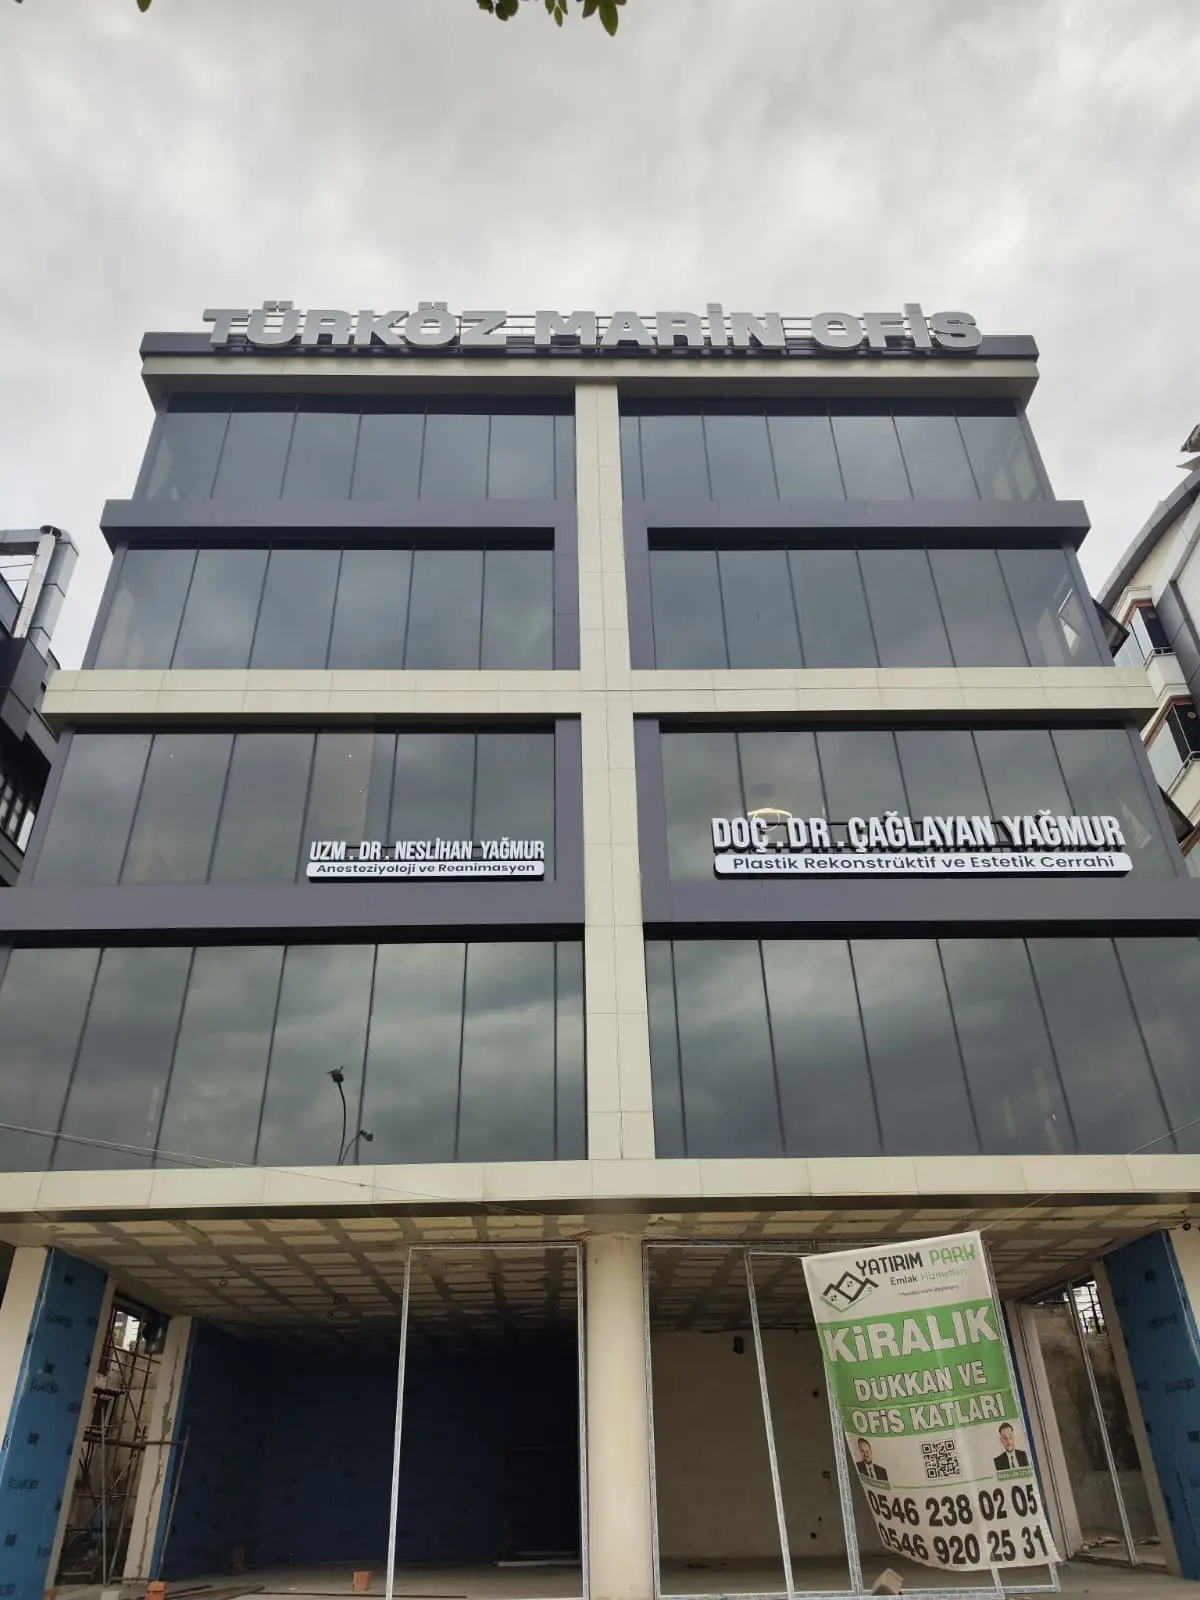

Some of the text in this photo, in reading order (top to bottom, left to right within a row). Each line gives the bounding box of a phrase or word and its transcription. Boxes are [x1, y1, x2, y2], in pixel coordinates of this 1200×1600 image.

[202, 301, 983, 351] TÜRKÖZ MARİN OFİS
[394, 837, 473, 860] NESLİHAN
[480, 836, 545, 860] YAĞMUR
[848, 810, 996, 853] ÇAĞLAYAN
[1001, 809, 1126, 847] YAĞMUR
[316, 863, 416, 875] Anesteziyoloji
[438, 863, 535, 874] Reanimasyon
[732, 855, 1116, 870] Plastik Rekonstrüktif ve Estetik Cerrahi
[856, 1243, 976, 1276] YATIRIM PARK
[890, 1274, 918, 1286] Emlak
[853, 1360, 987, 1402] DÜKKAN VE
[909, 1392, 1006, 1432] KATLARI
[867, 1484, 1038, 1527] 0546 238 02 05
[878, 1523, 1049, 1565] 0546 920 25 31
